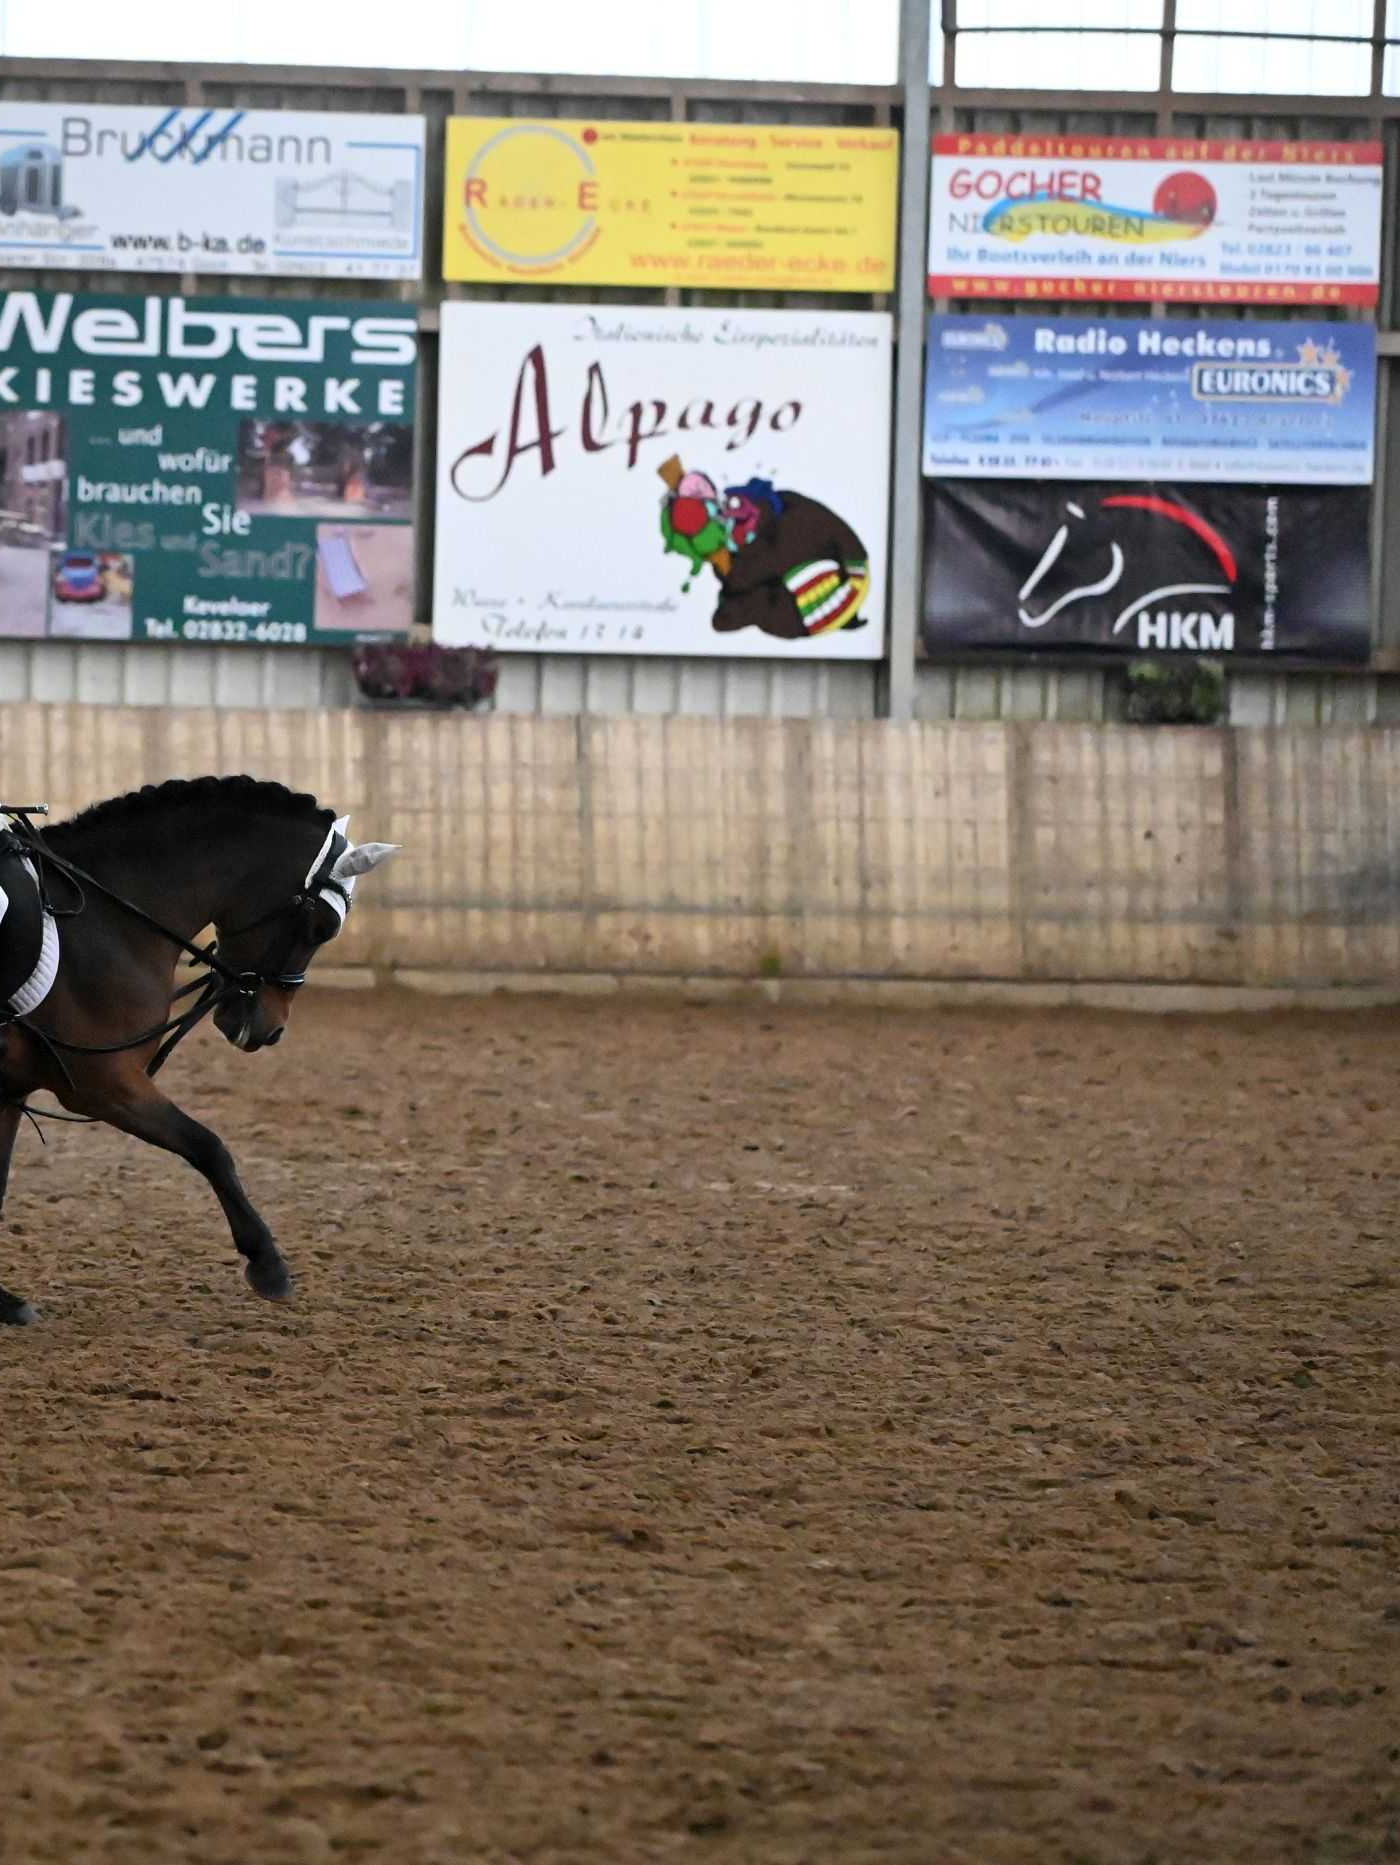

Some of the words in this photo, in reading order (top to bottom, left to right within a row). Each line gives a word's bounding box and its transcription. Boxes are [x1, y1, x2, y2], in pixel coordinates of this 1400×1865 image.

[957, 137, 1150, 159] Paddeltouren
[1165, 141, 1208, 160] auf
[1223, 141, 1265, 161] der
[1282, 143, 1353, 162] Niers
[949, 169, 1103, 202] GOCHER
[111, 230, 267, 254] www.b-ka.de
[947, 248, 970, 262] Ihr
[977, 248, 1091, 266] Bootsverleih
[1097, 253, 1120, 266] an
[1124, 251, 1153, 266] der
[1160, 252, 1206, 268] Niers
[1034, 327, 1127, 356] Radio
[1138, 330, 1271, 358] Heckens
[1200, 368, 1331, 396] EURONICS
[118, 424, 163, 447] und
[450, 343, 803, 502] Alpago
[157, 447, 232, 474] wofür
[77, 475, 202, 505] brauchen
[74, 512, 155, 549] Kies
[202, 503, 252, 536] Sie
[197, 539, 313, 579] Sand?
[183, 594, 271, 617] Kevelaer
[145, 617, 179, 639] Tel.
[183, 619, 308, 644] 02832-6028
[481, 612, 569, 642] Telefon
[1137, 611, 1236, 650] HKM
